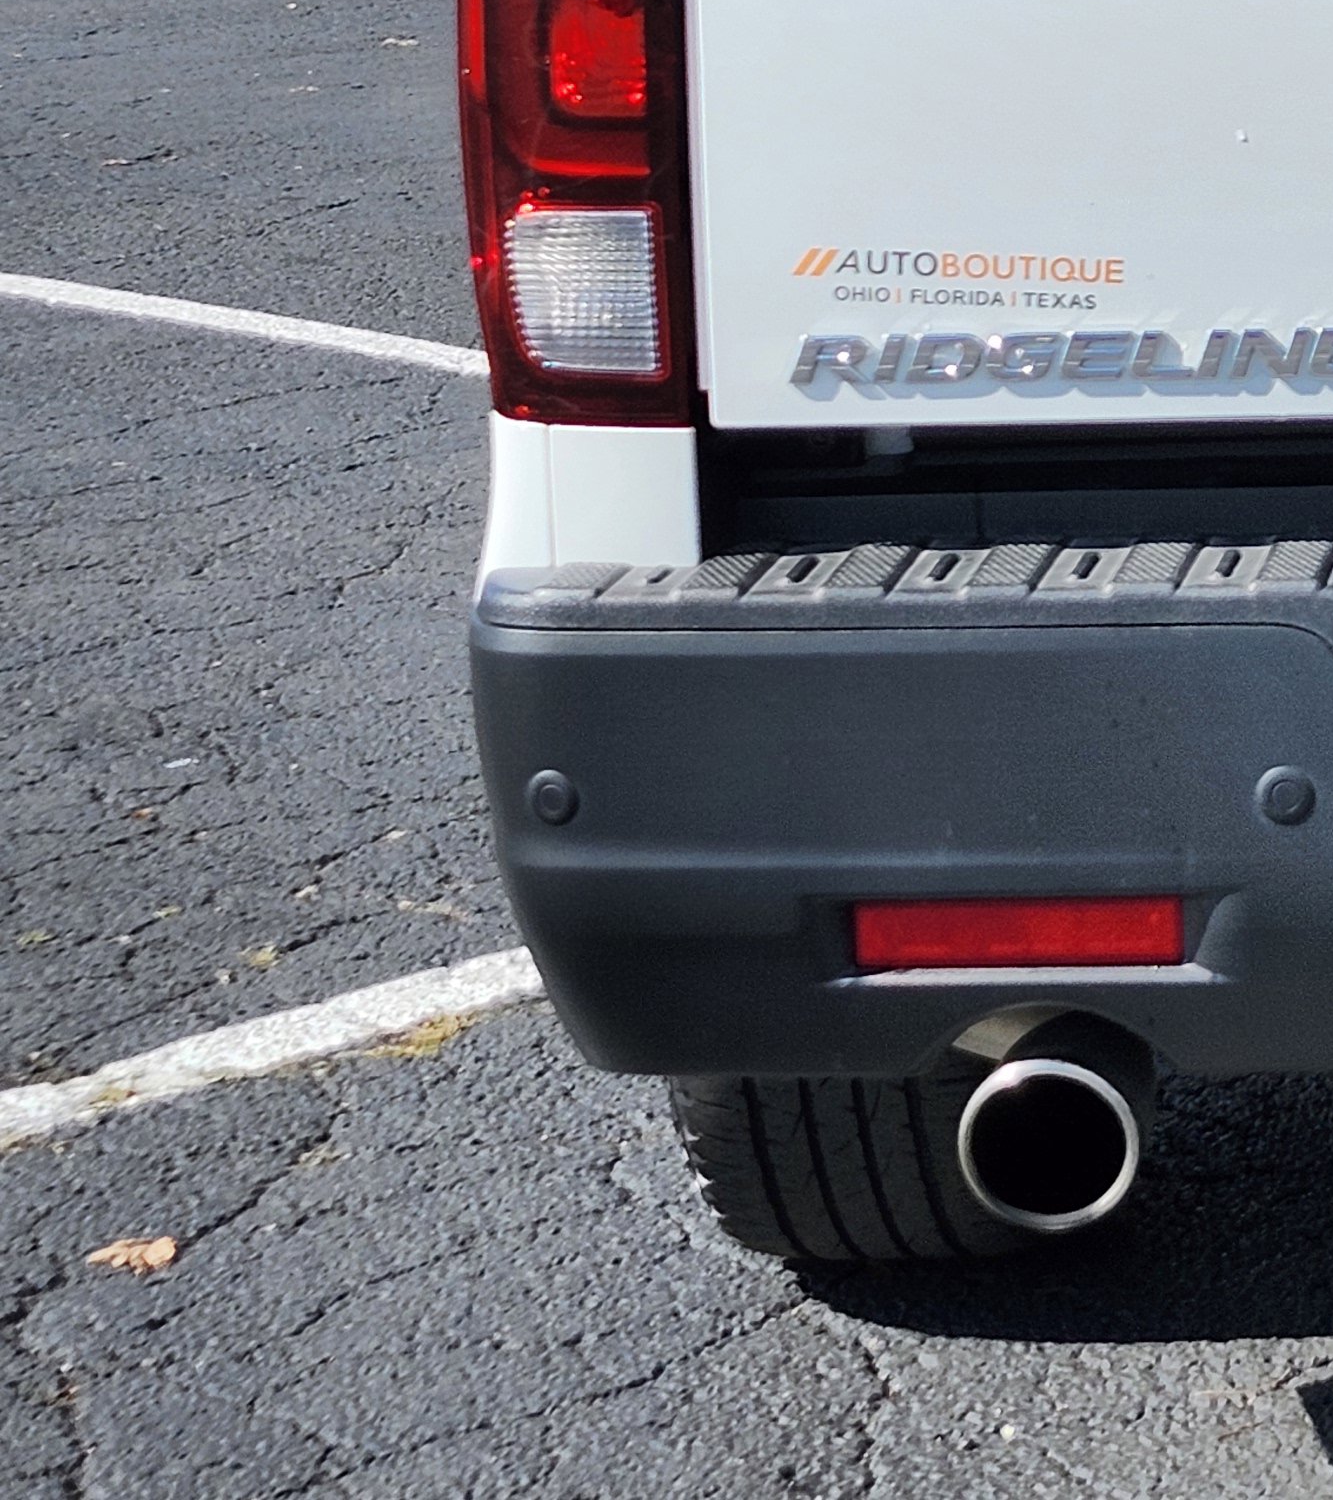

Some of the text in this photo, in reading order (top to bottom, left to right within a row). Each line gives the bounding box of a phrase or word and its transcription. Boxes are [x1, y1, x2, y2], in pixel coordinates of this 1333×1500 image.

[836, 248, 1125, 284] AUTOBOUTIQUE
[834, 285, 1098, 311] OHIO FLORIDA TEXAS
